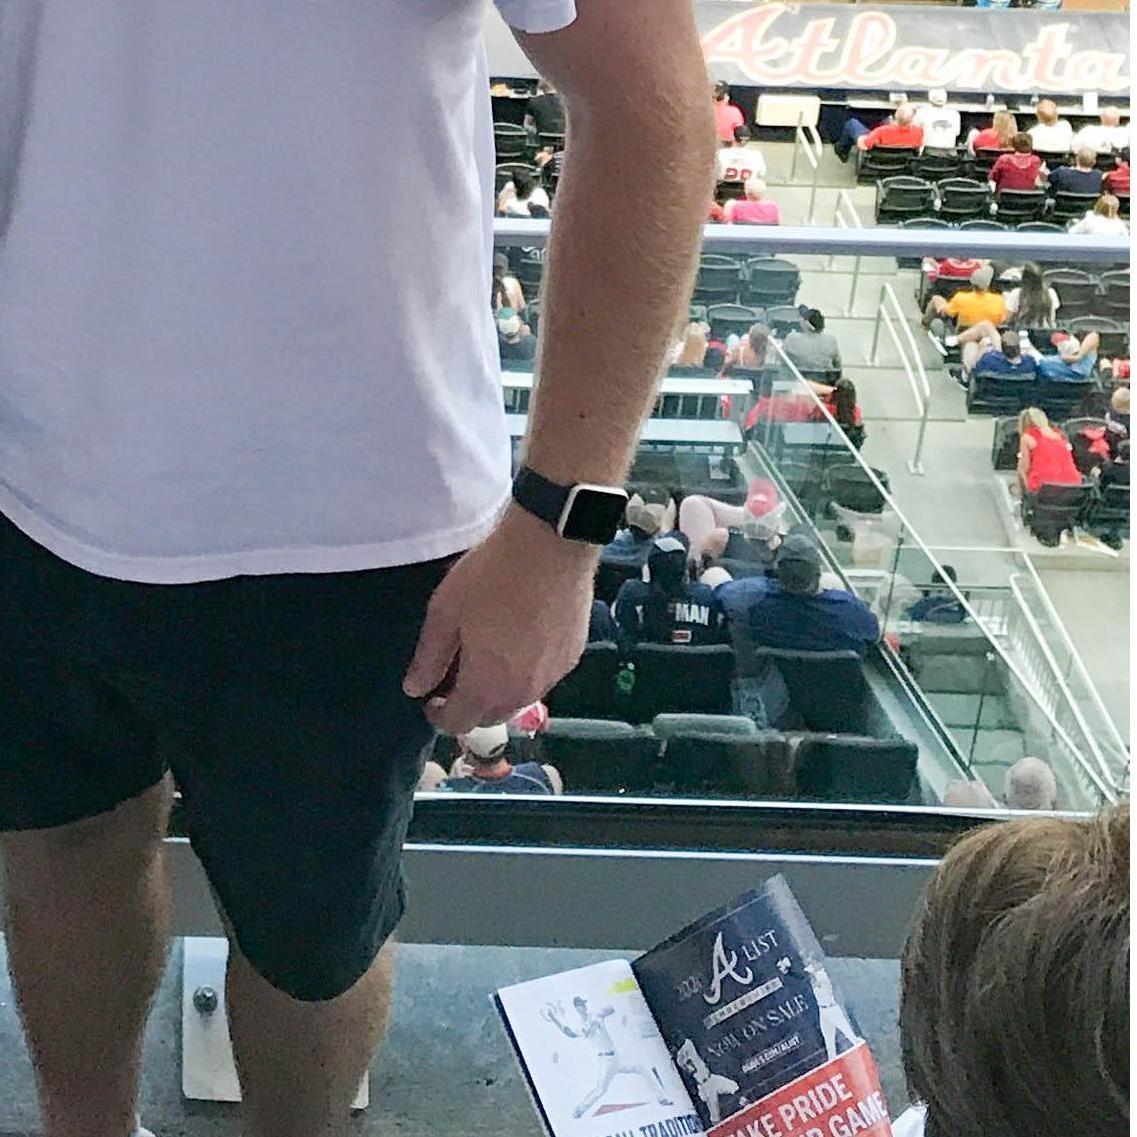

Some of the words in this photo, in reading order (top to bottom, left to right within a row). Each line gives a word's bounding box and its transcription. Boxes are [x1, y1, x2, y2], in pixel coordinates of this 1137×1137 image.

[701, 2, 1130, 91] Atlanta
[741, 929, 779, 962] LIST
[777, 1073, 854, 1131] PRIDE
[828, 1090, 889, 1137] GAME
